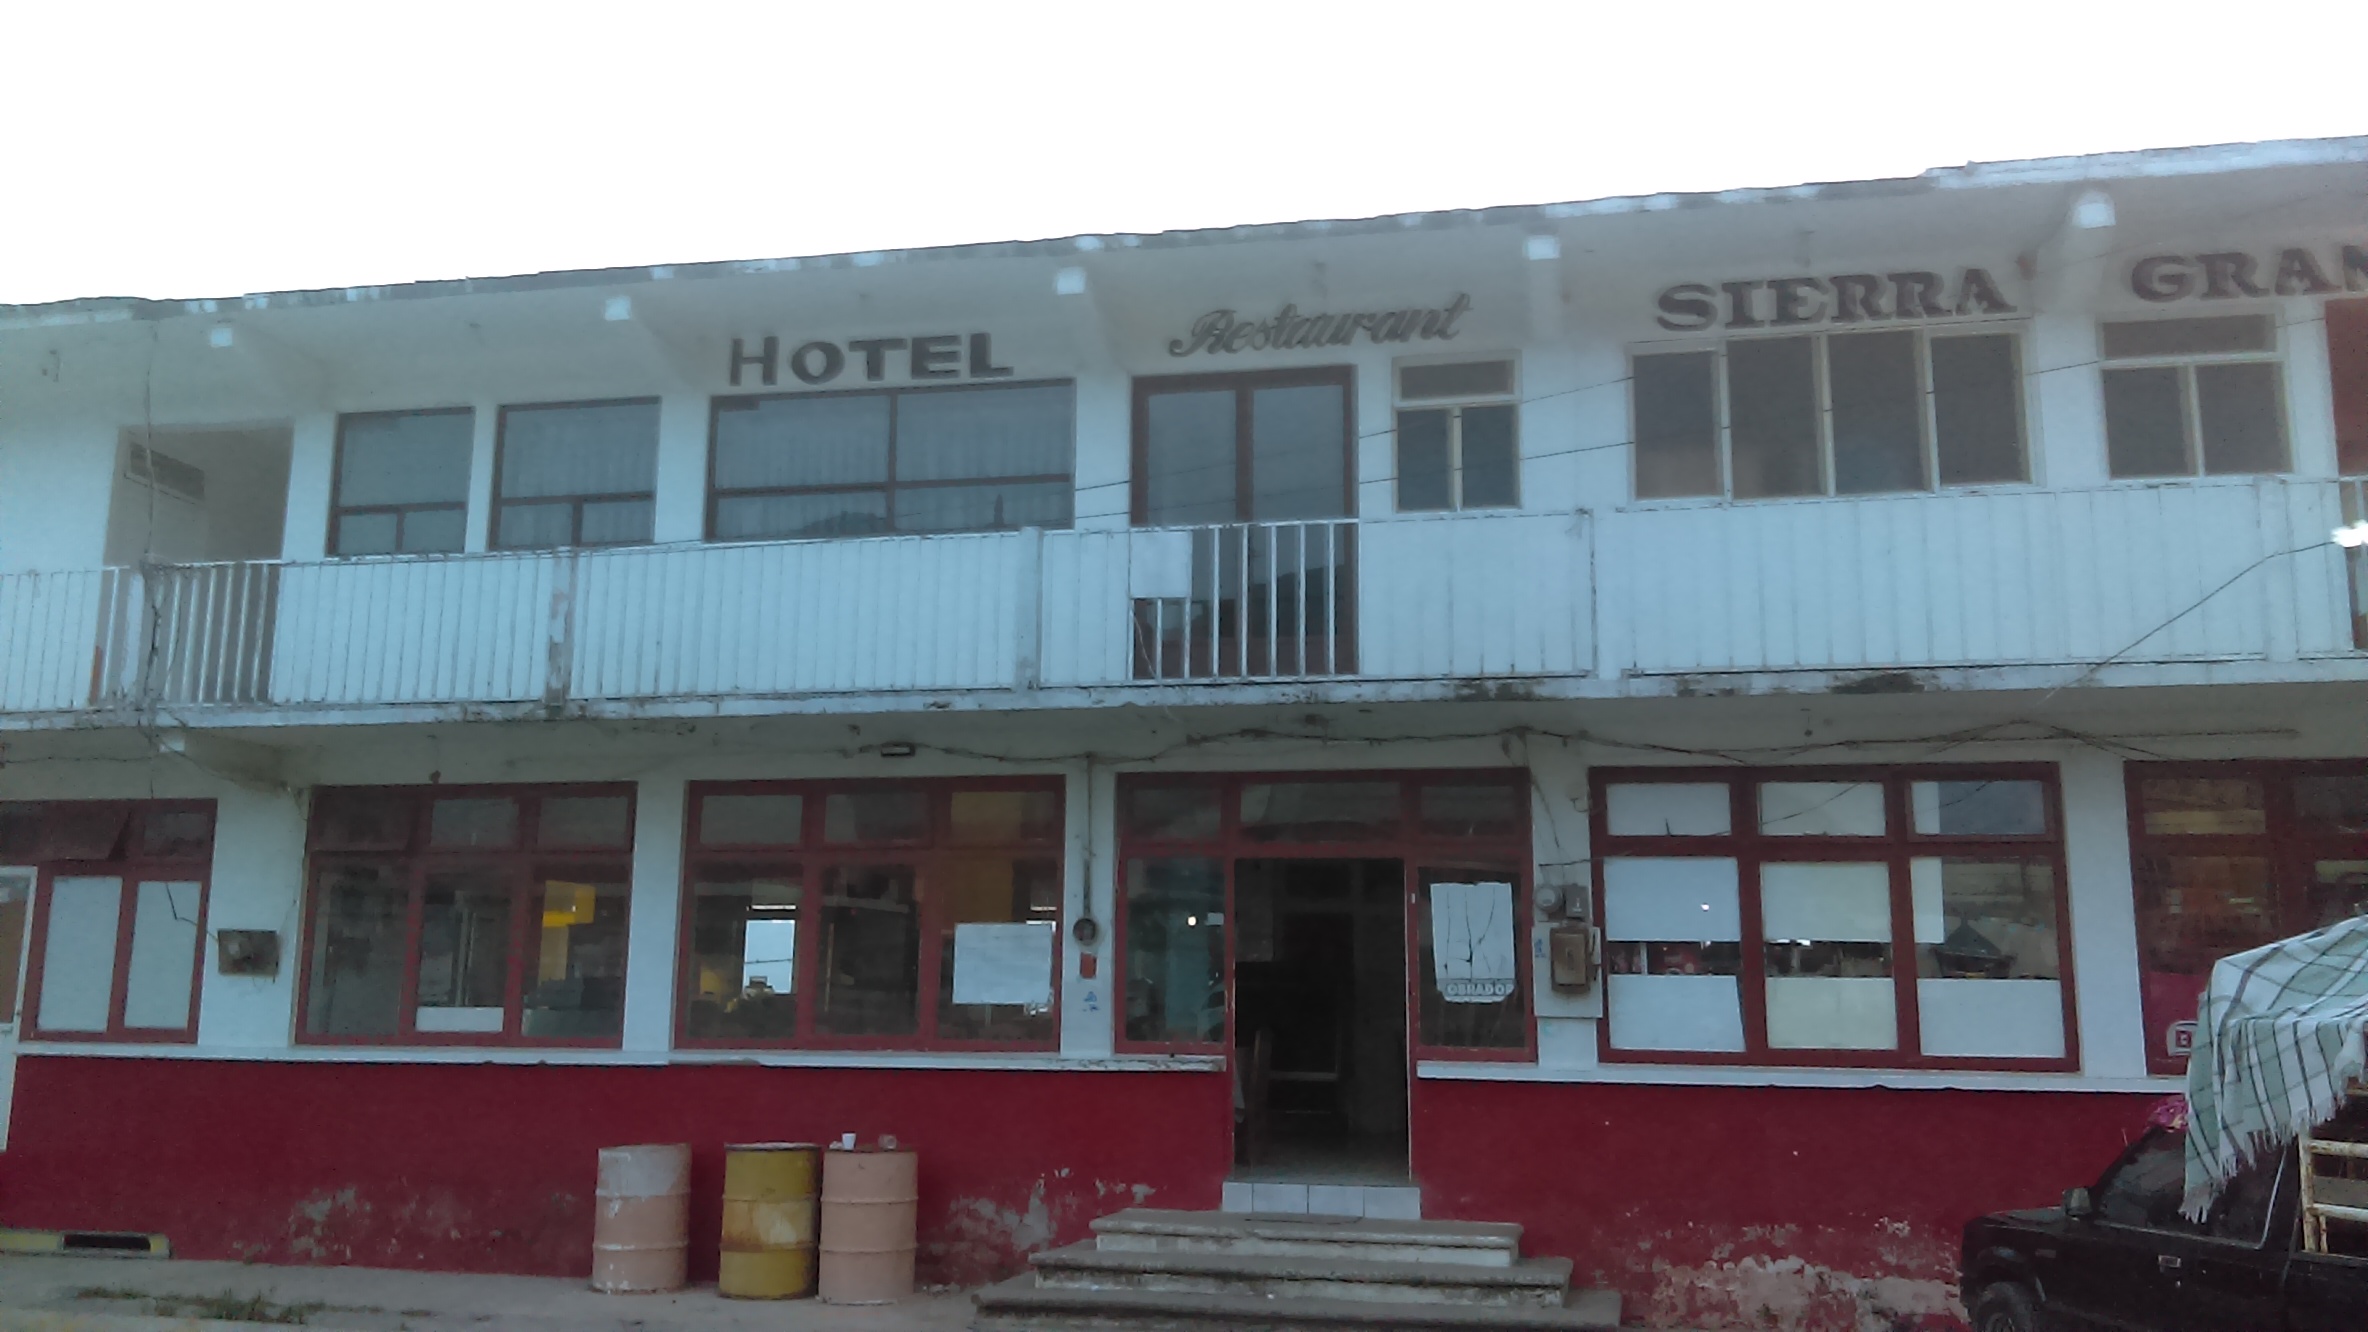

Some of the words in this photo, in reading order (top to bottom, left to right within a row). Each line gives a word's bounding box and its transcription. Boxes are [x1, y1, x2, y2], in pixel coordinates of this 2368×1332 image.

[1168, 292, 1473, 358] Restaurant
[1656, 267, 2018, 332] SIERRA
[729, 332, 1014, 386] HOTEL
